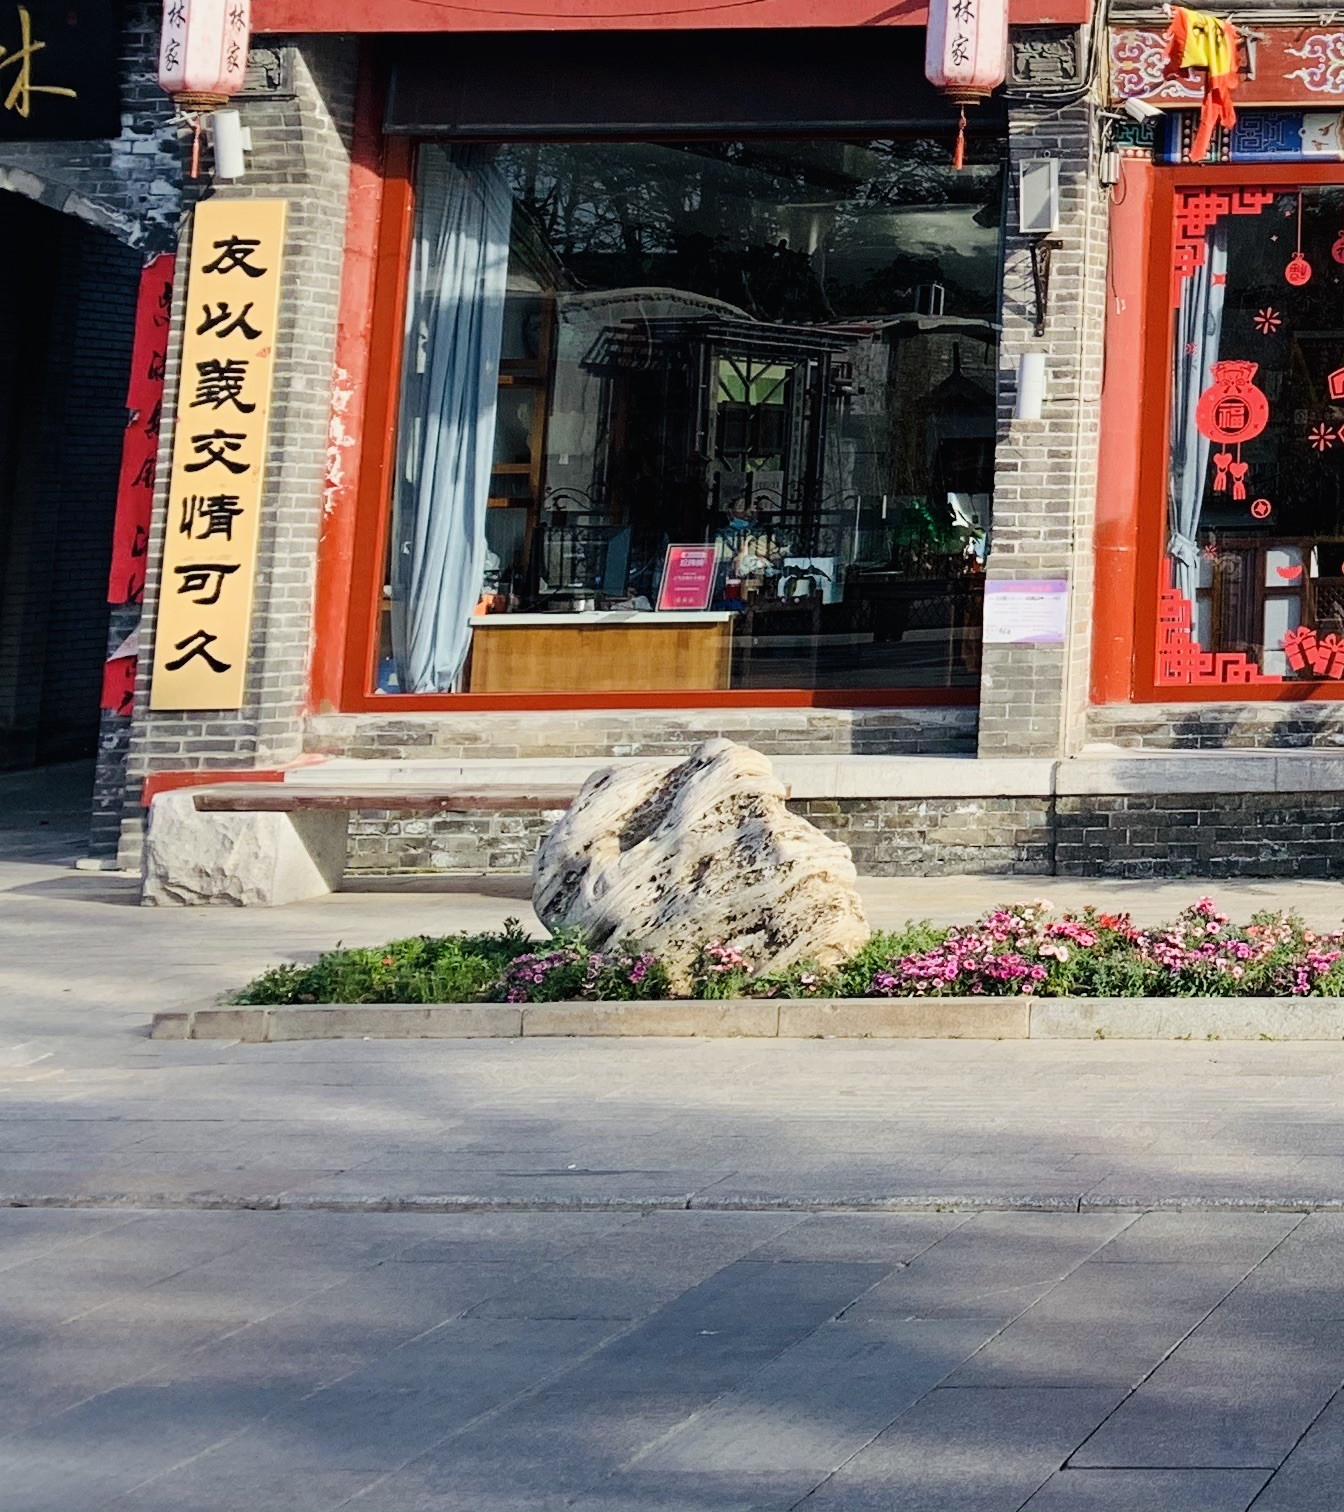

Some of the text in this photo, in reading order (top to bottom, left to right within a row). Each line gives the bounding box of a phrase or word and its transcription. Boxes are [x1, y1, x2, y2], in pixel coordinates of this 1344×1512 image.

[165, 0, 186, 72] 林家
[227, 3, 246, 74] 林家
[1218, 403, 1245, 428] 福
